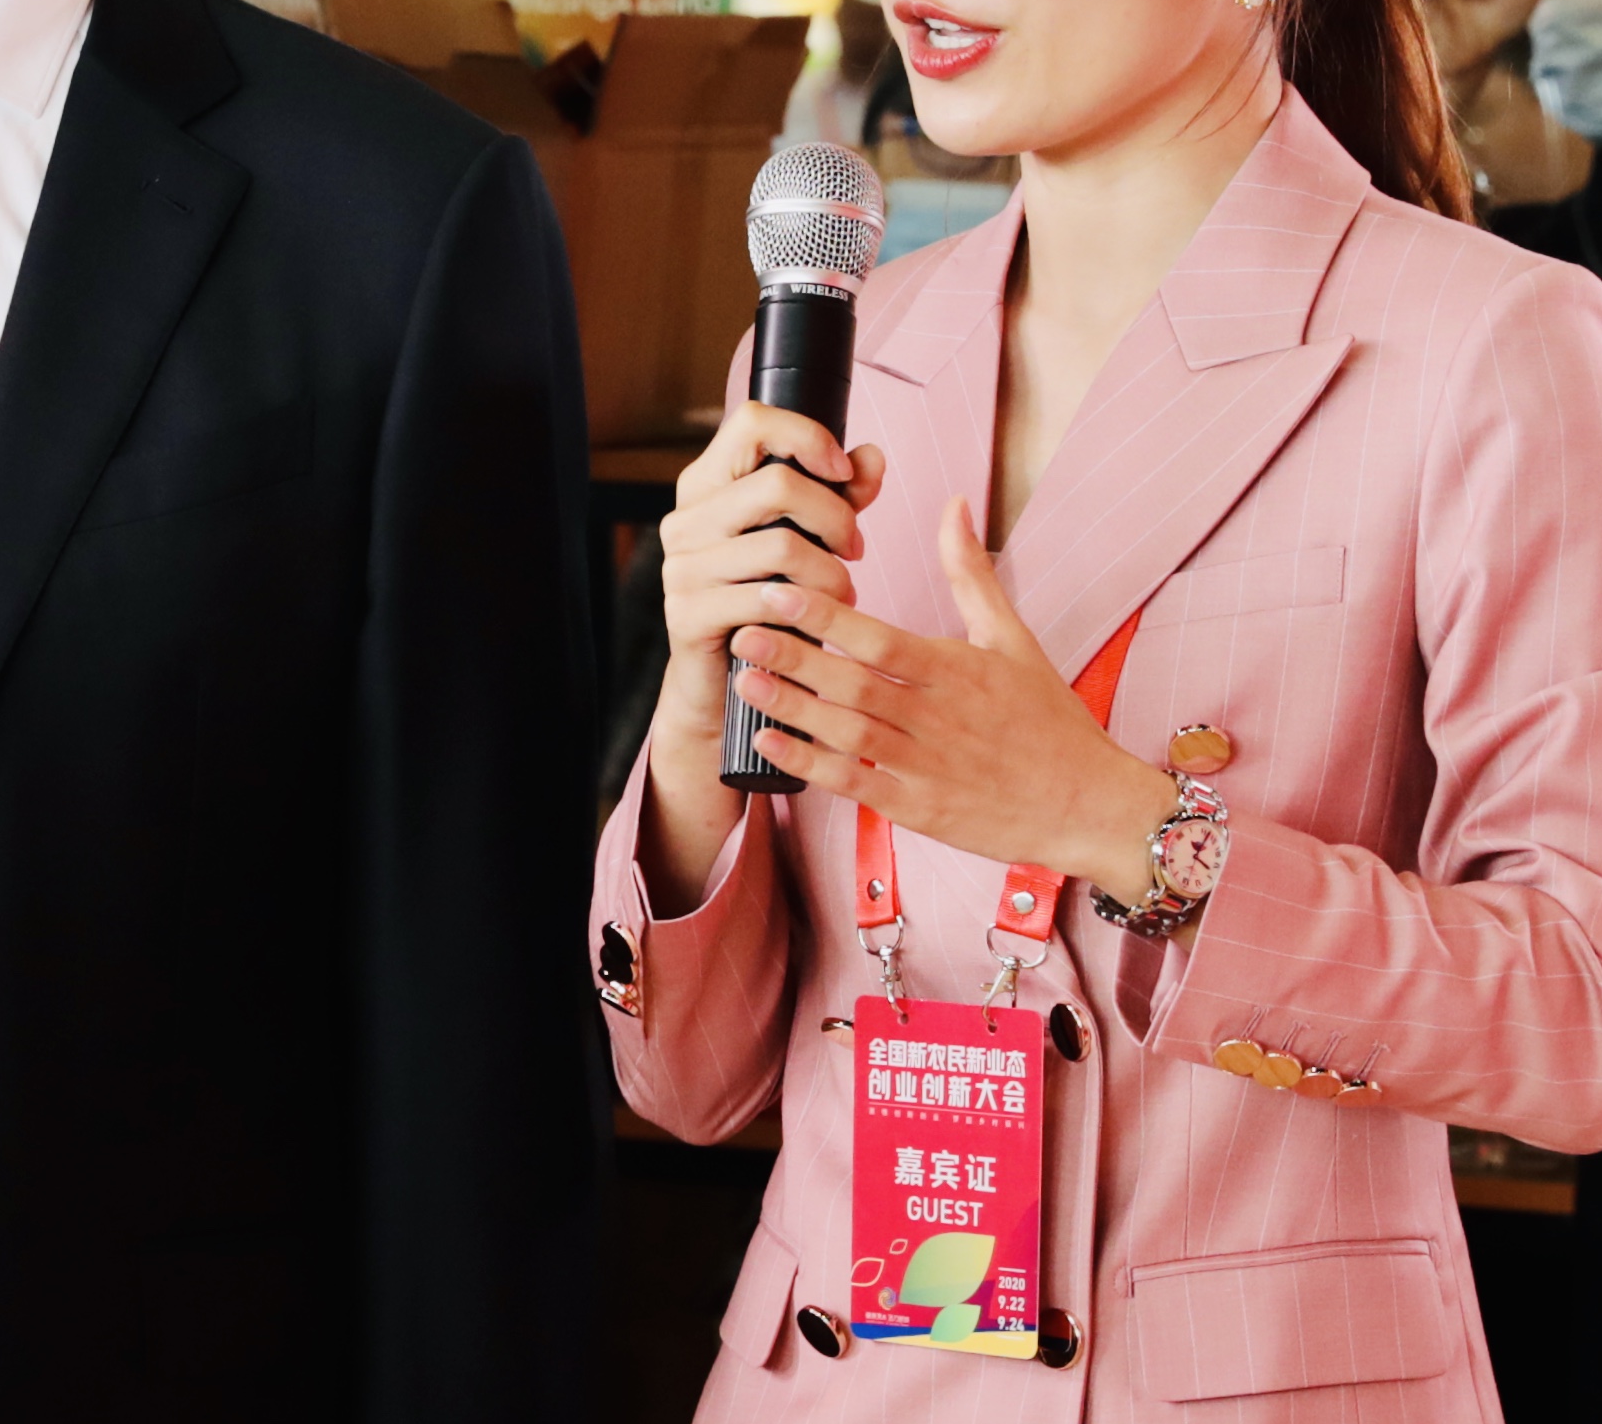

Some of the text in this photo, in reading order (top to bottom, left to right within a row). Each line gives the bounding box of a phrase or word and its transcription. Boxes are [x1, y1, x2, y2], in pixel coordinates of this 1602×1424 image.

[790, 283, 849, 302] WIRELESS
[868, 1037, 1026, 1078] 全国新农民新业态
[868, 1068, 1025, 1114] 创业创新大会
[894, 1147, 997, 1194] 嘉宾证
[906, 1196, 983, 1227] GUEST
[998, 1276, 1026, 1291] 2020
[998, 1295, 1025, 1312] 9.22
[998, 1315, 1025, 1332] 9.24
